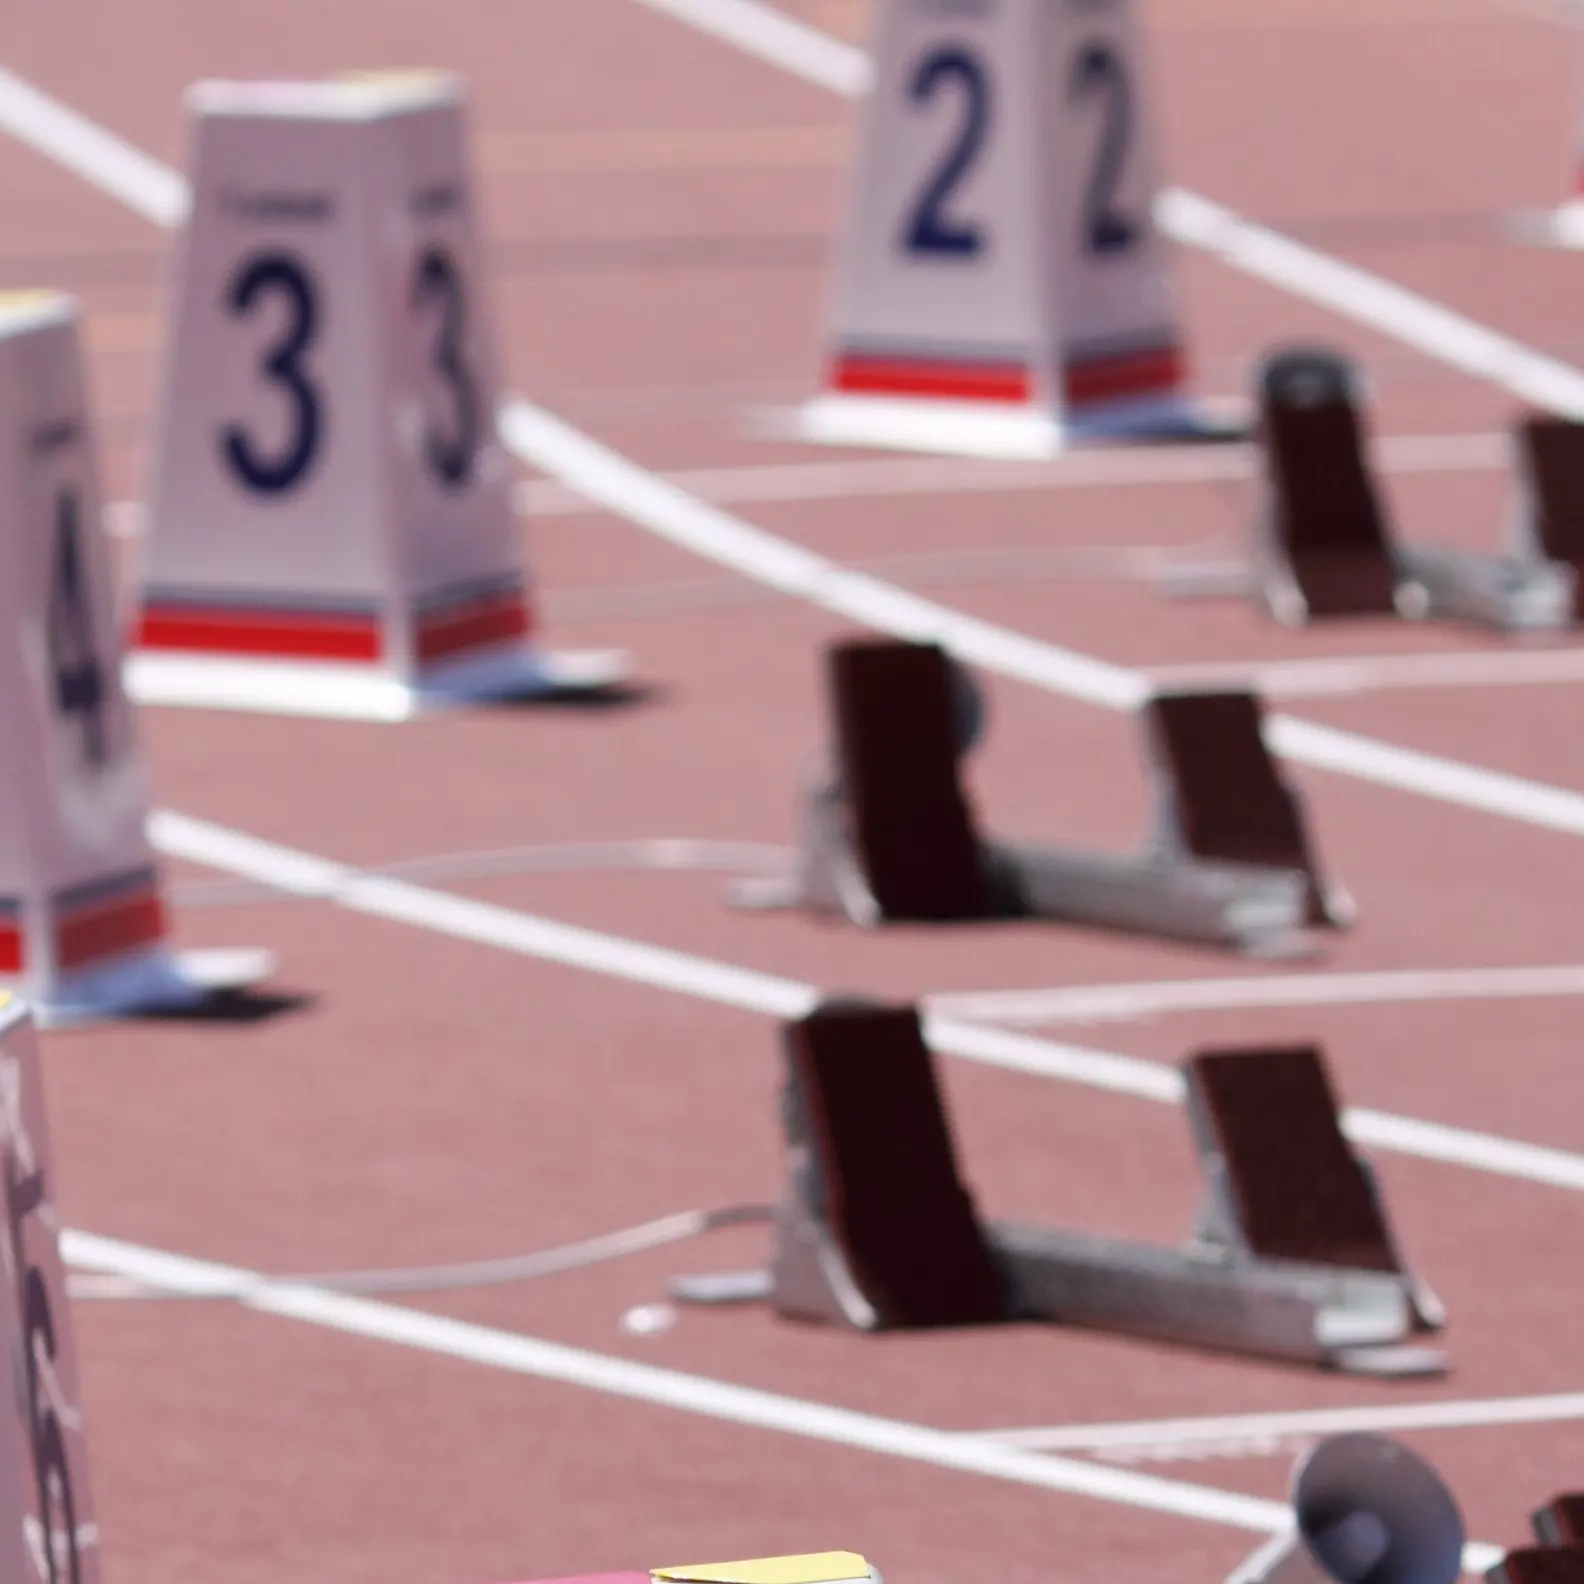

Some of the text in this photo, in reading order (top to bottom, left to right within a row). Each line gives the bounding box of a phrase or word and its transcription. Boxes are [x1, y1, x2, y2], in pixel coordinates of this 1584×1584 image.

[900, 45, 990, 259] 2
[1075, 43, 1141, 260] 2
[221, 251, 322, 496] 3
[413, 246, 478, 490] 3
